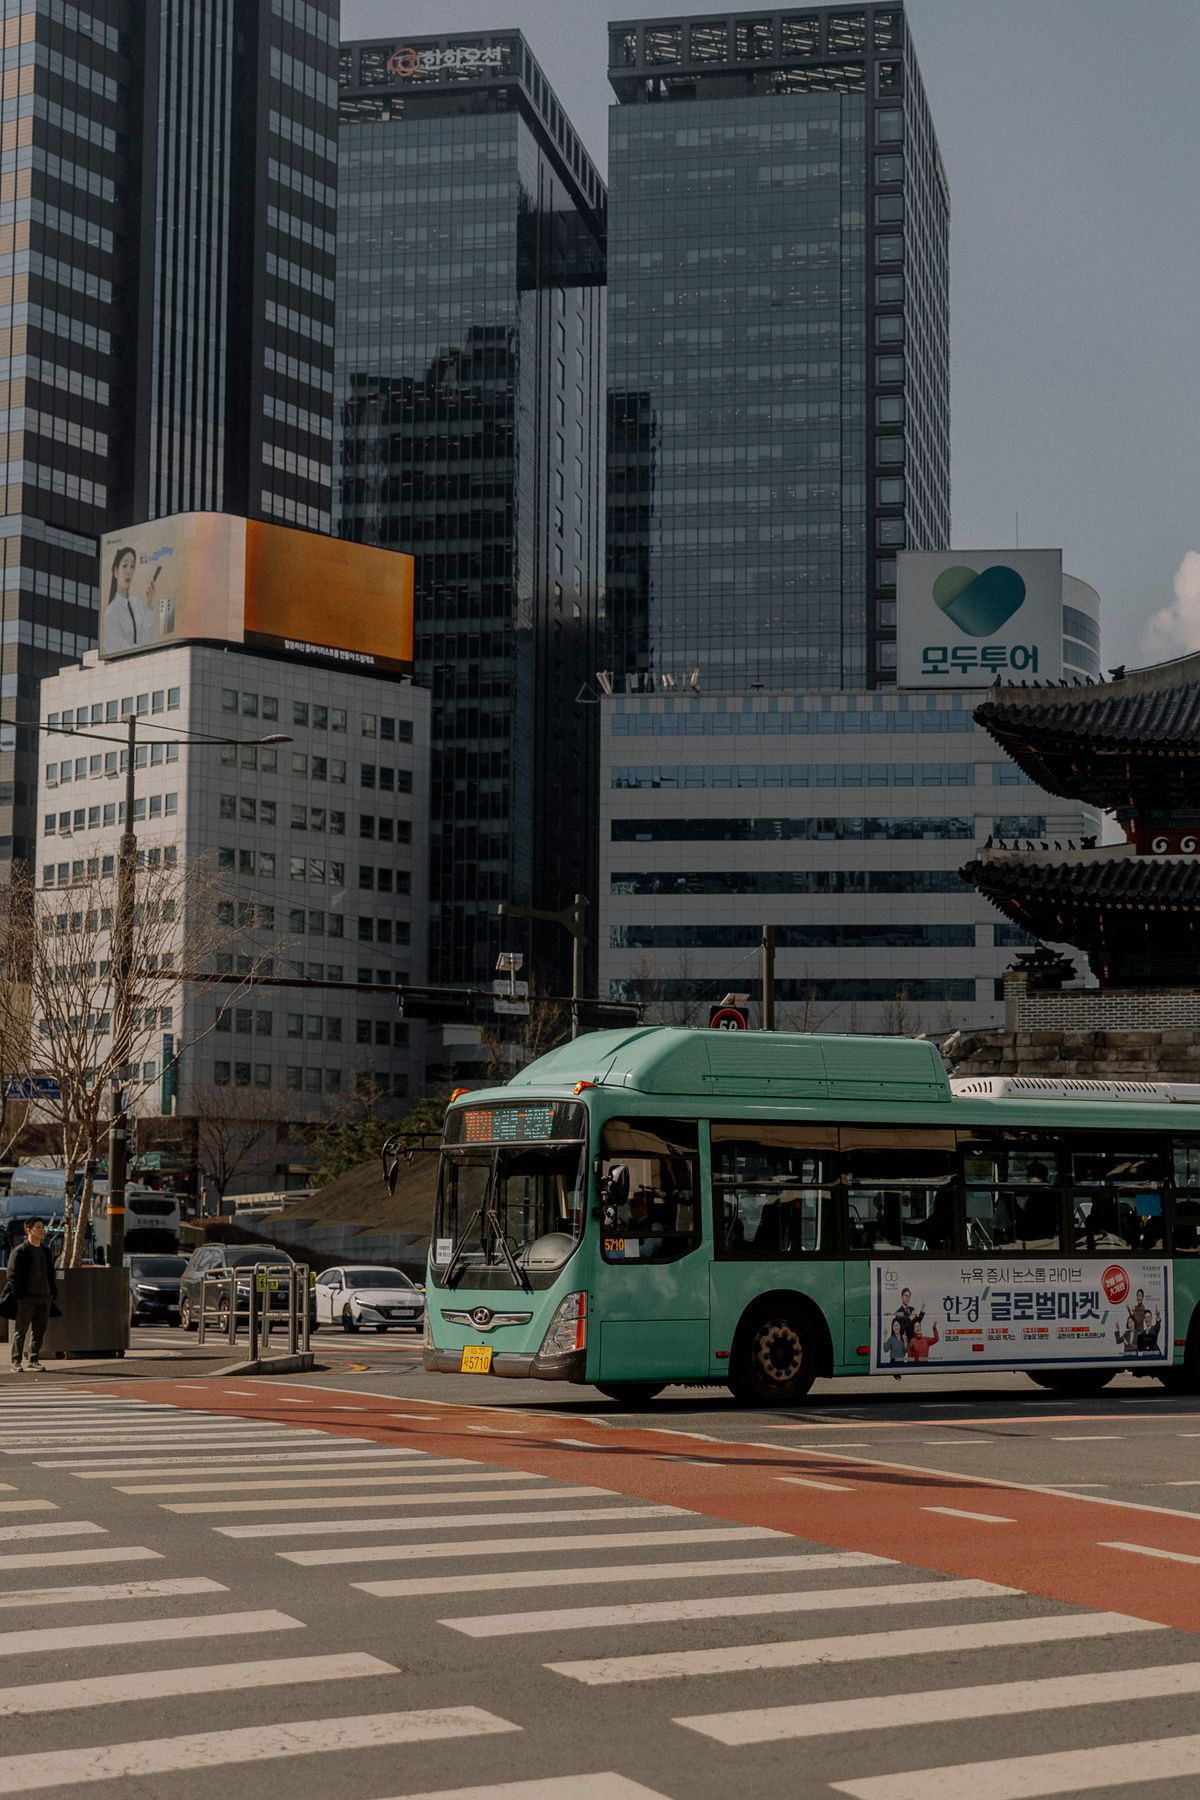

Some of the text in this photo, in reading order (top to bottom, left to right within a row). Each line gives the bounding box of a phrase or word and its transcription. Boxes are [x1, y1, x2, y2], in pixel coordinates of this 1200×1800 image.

[423, 46, 502, 70] 한화오션
[921, 645, 1039, 675] 모두투어
[719, 1020, 738, 1031] 50
[604, 1238, 625, 1251] 5710
[960, 1267, 1082, 1284] 뉴욕 증시 논스톱 라이브
[942, 1291, 1100, 1323] 한경 글로벌마켓
